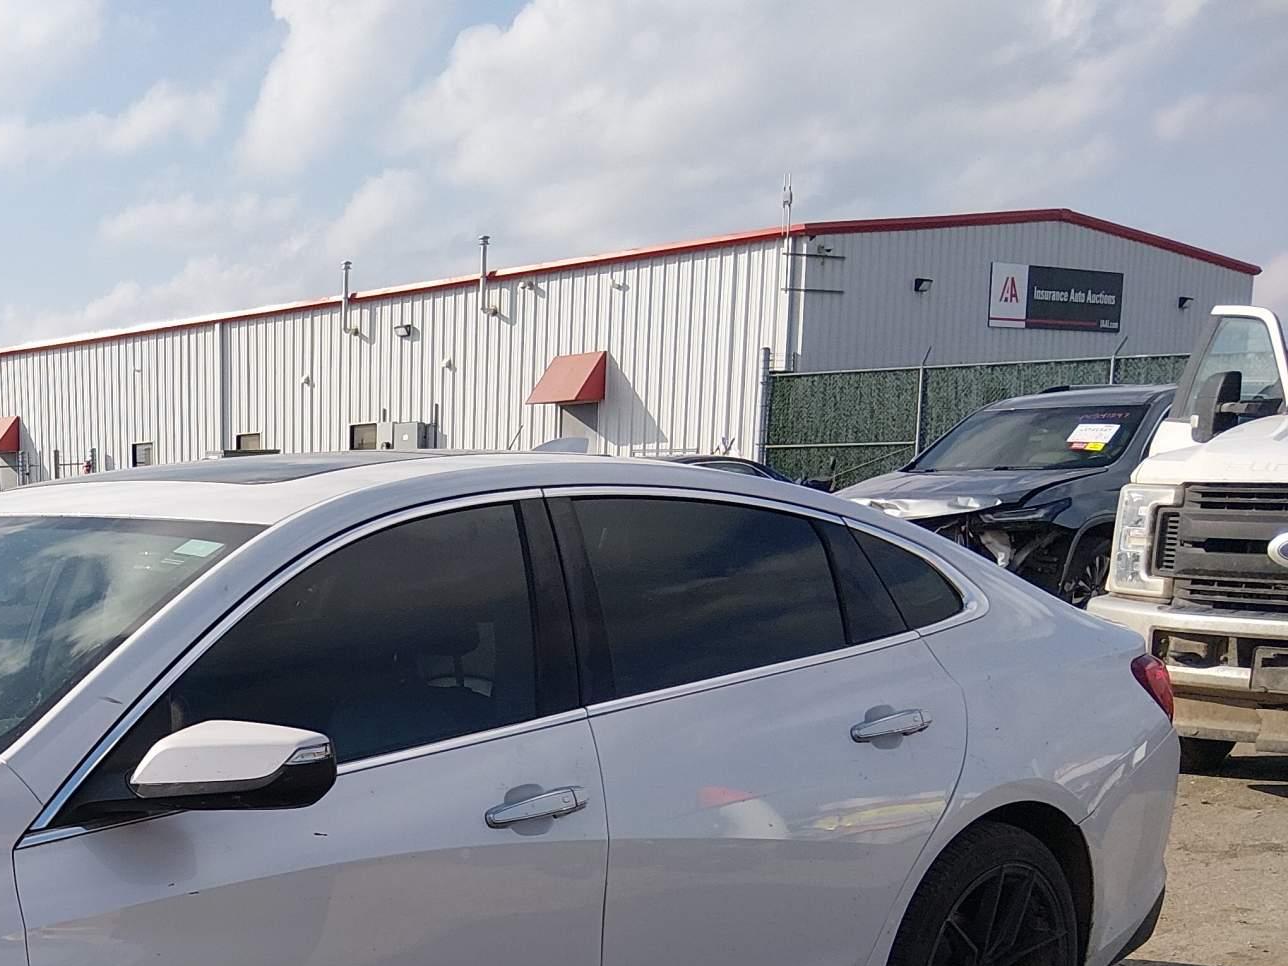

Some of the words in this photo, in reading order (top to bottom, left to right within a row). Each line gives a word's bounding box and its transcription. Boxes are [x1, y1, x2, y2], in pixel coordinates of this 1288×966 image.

[1033, 285, 1069, 302] Insurance
[1069, 288, 1086, 303] Auto
[1086, 289, 1116, 305] Auctions
